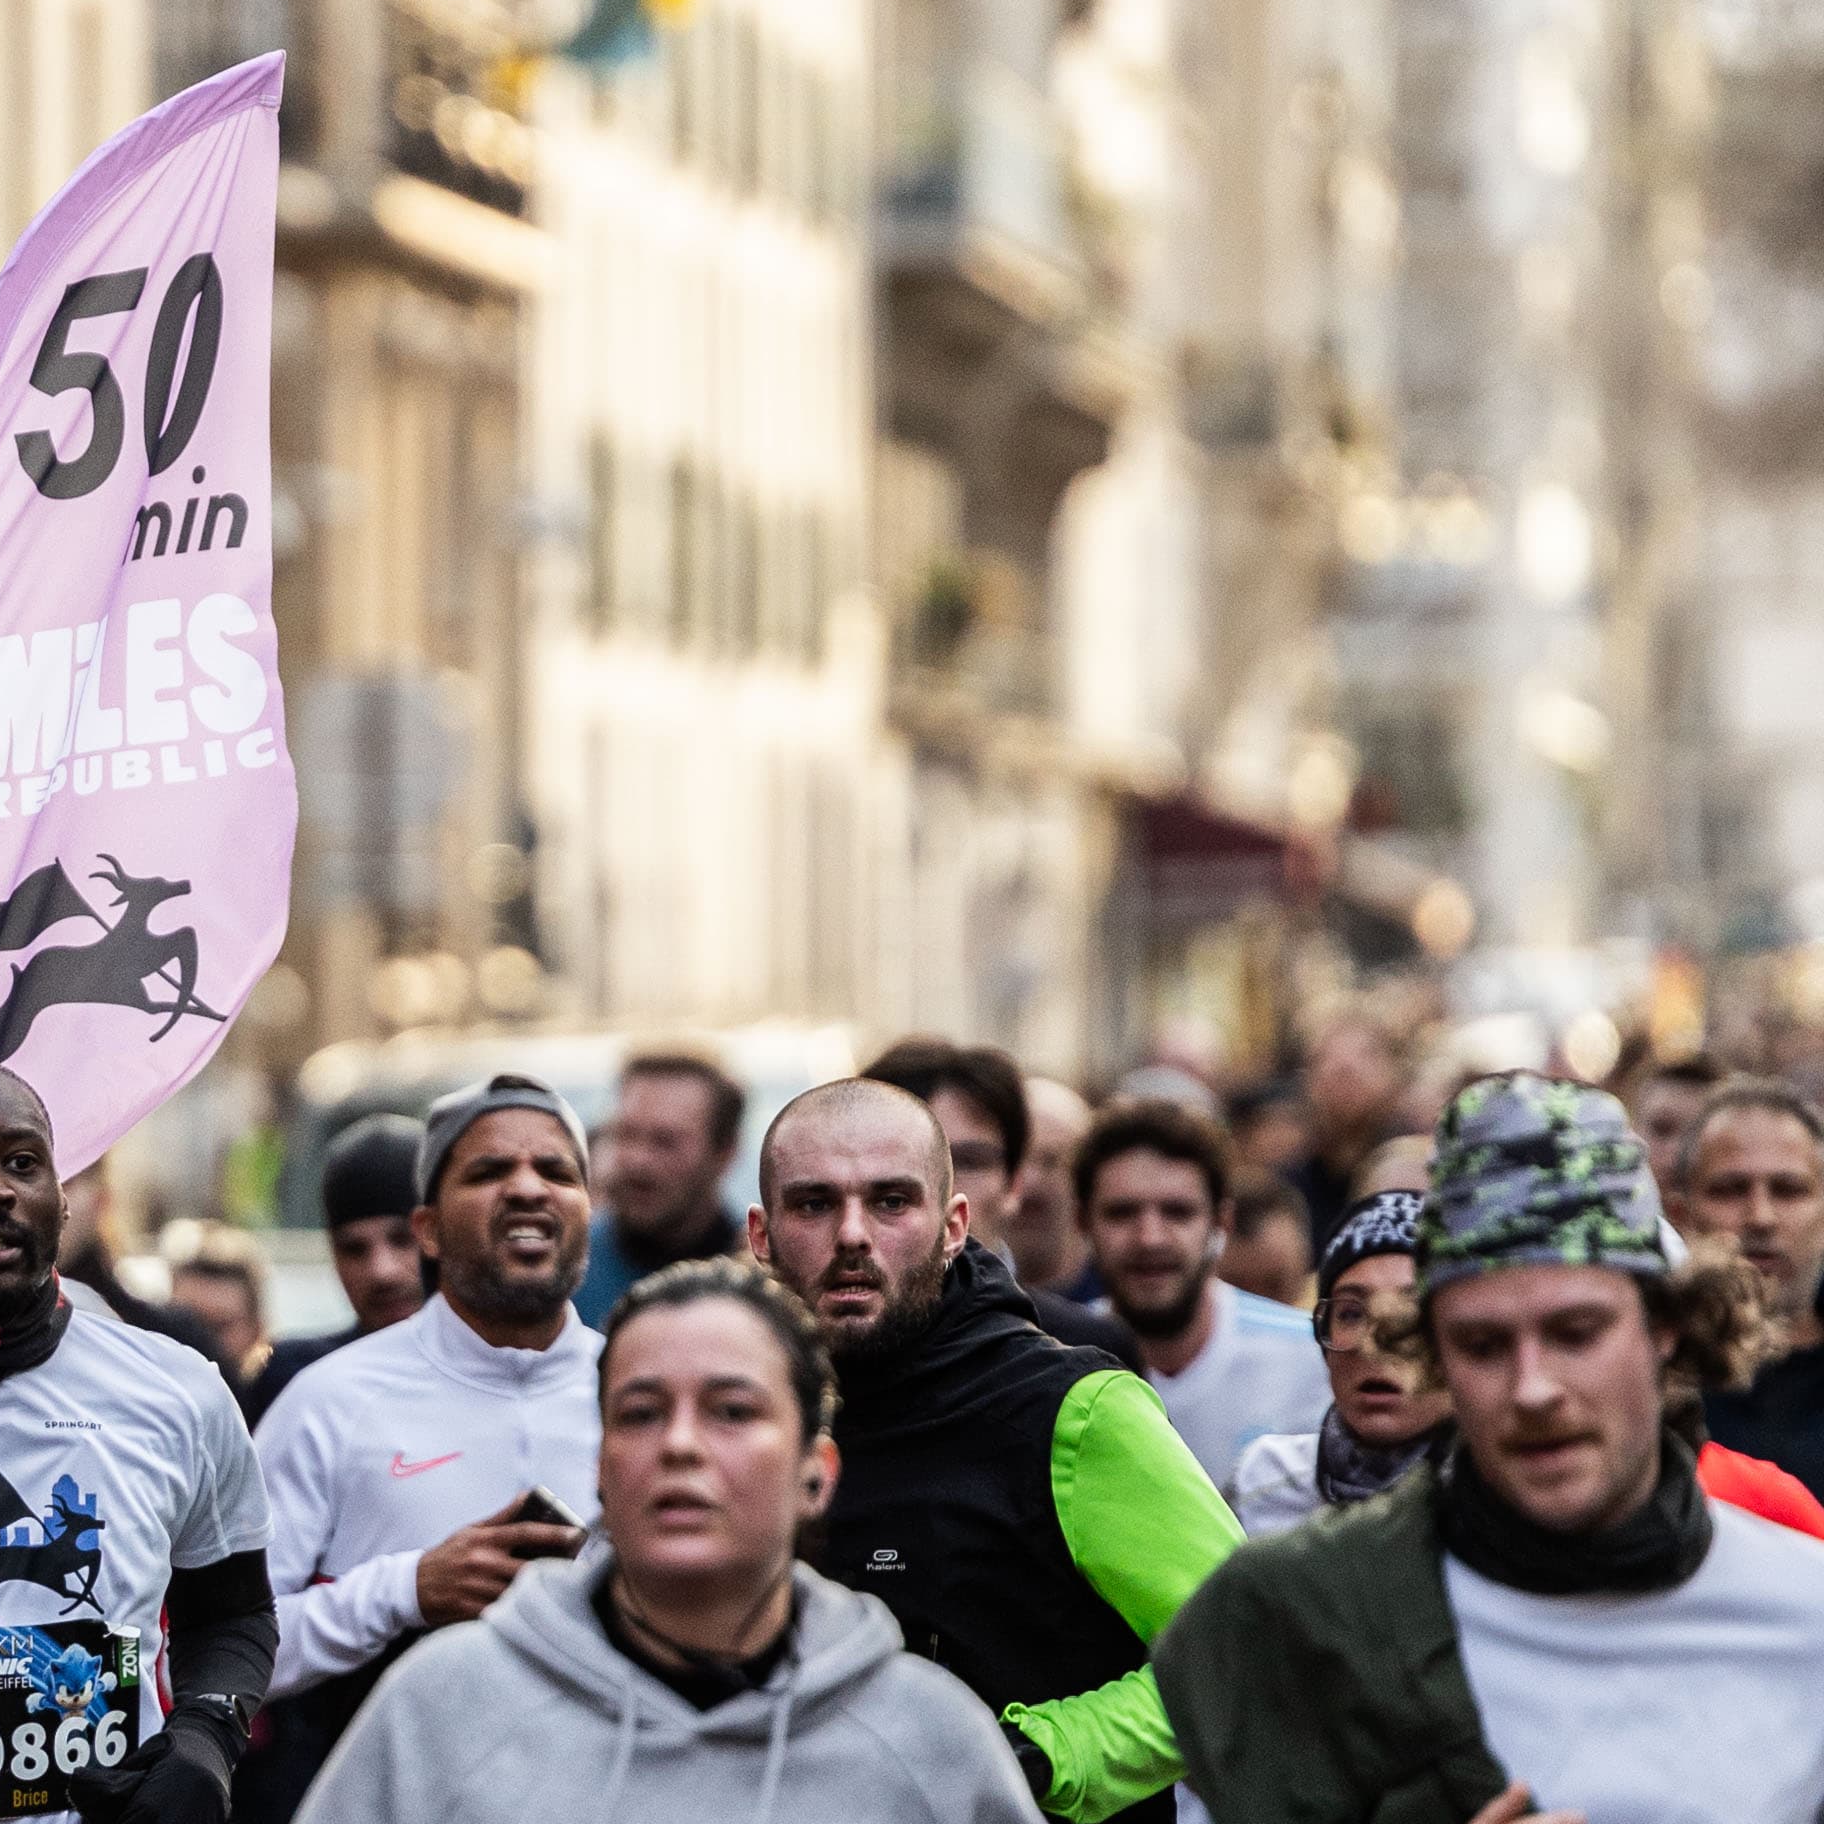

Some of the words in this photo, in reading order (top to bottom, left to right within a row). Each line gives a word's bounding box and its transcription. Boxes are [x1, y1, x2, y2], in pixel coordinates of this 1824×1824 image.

[14, 252, 224, 500] 50
[1352, 1220, 1418, 1251] FAC
[12, 1787, 49, 1808] Brice
